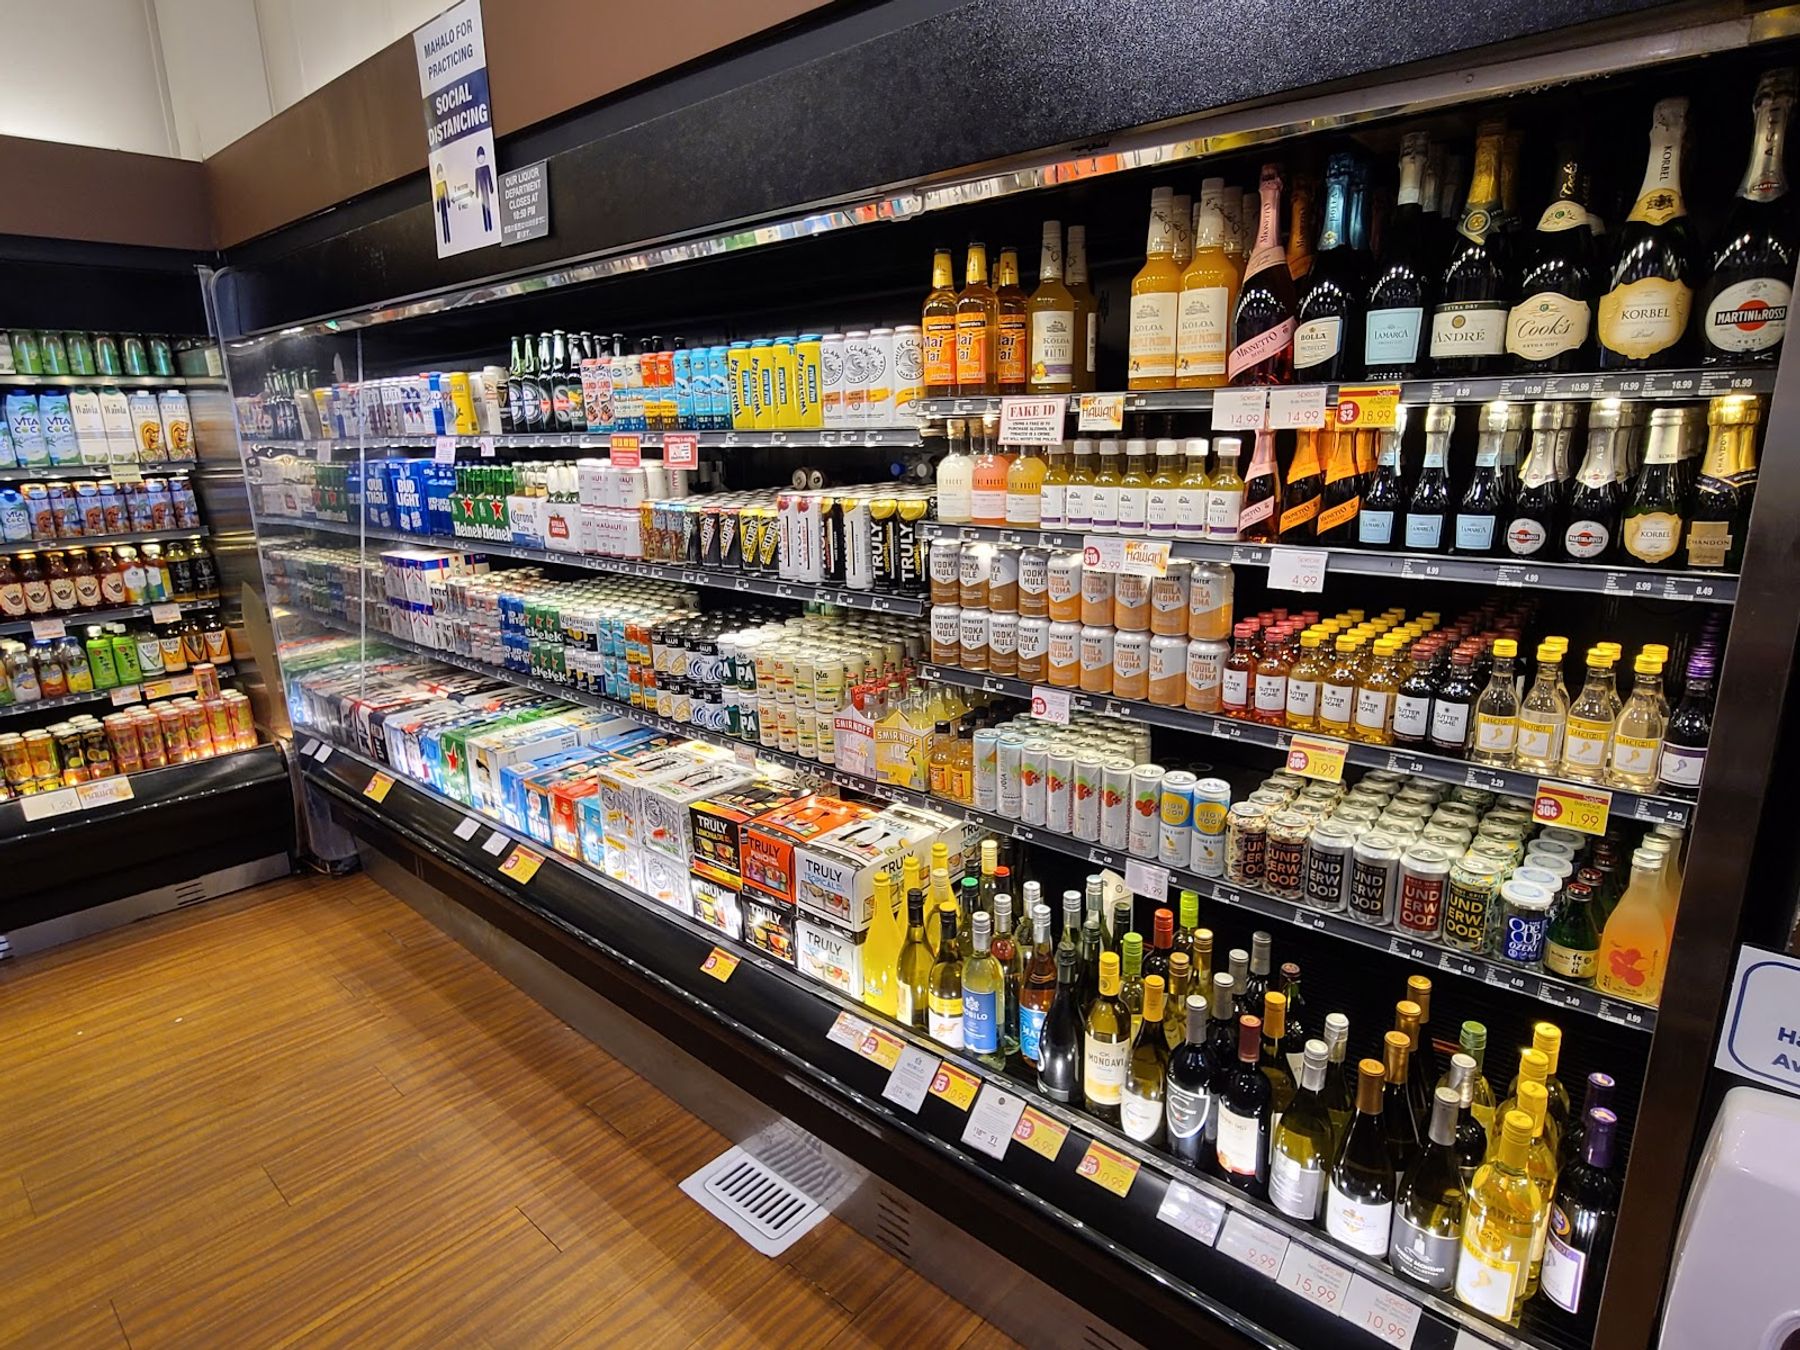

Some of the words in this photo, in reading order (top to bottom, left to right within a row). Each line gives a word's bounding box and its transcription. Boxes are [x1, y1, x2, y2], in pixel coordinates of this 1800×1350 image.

[423, 28, 456, 59] MAHALO
[456, 19, 473, 41] FOR
[427, 43, 474, 81] PRACTICING
[435, 82, 473, 116] SOCIAL
[427, 103, 489, 147] DISTANCING
[1657, 144, 1673, 181] KORBEL
[505, 175, 518, 187] OUR
[518, 167, 540, 183] LIQUOR
[505, 179, 541, 199] DEPARTMENT
[508, 197, 531, 210] CLOSES
[531, 193, 539, 203] AT
[1620, 307, 1672, 321] KORBEL
[1434, 328, 1486, 344] ANDRÉ
[1515, 317, 1575, 340] Cook's
[1300, 332, 1327, 341] BOLLA
[730, 358, 740, 375] TEA
[752, 356, 761, 373] TEA
[797, 353, 807, 369] TEA
[1524, 386, 1542, 395] 10.99
[1571, 382, 1590, 392] 10.99
[1619, 381, 1640, 391] 16.99
[1671, 380, 1693, 390] 16.99
[1730, 378, 1753, 388] 16.99
[730, 376, 742, 418] TWISTED
[751, 372, 762, 417] TWISTED
[798, 369, 808, 416] TWISTED
[1297, 391, 1320, 399] Special
[1377, 388, 1394, 397] Sale
[1010, 406, 1040, 418] FAKE
[1043, 405, 1056, 416] ID
[1230, 414, 1260, 424] 14.99
[1287, 411, 1319, 423] 14.99
[1339, 409, 1355, 422] $2
[1361, 410, 1391, 424] 18.99
[14, 417, 40, 426] VITA
[47, 417, 71, 426] VITA
[396, 479, 415, 494] BUD
[395, 492, 420, 508] LIGHT
[510, 510, 534, 524] Corona
[482, 525, 513, 542] Heinek
[1640, 530, 1672, 539] KORBEL
[870, 522, 884, 579] TRULY
[1688, 539, 1730, 547] CHANDON
[900, 522, 914, 582] TRULY
[1085, 553, 1099, 564] $10
[933, 561, 958, 569] VODKA
[1101, 561, 1121, 570] 5.99
[1022, 569, 1048, 577] VODKA
[1292, 574, 1318, 586] 4.99
[1524, 573, 1539, 583] 4.99
[1024, 577, 1046, 585] MULE
[1696, 586, 1713, 596] 8.49
[935, 622, 959, 630] VODKA
[936, 629, 957, 637] MULE
[992, 630, 1016, 639] VODKA
[994, 637, 1014, 646] MULE
[1189, 652, 1219, 660] CUTWATER
[835, 718, 872, 736] SMIRNOFF
[877, 731, 919, 748] SMIRNOFF
[1312, 761, 1337, 775] 1.99
[697, 815, 727, 834] TRULY
[1569, 810, 1599, 827] 1.99
[695, 827, 724, 843] LEMONADE
[961, 824, 980, 836] TRU
[749, 837, 781, 858] TRULY
[805, 858, 843, 880] TRULY
[1310, 858, 1341, 872] UND
[803, 872, 837, 890] TROPICAL
[1309, 870, 1340, 883] ERW
[1353, 870, 1383, 886] UND
[1308, 883, 1339, 897] OOD
[1352, 884, 1382, 898] ERW
[1405, 886, 1439, 901] UND
[1351, 896, 1381, 910] OOD
[1404, 899, 1438, 914] ERW
[1450, 895, 1483, 914] UND
[749, 903, 782, 924] TRULY
[1402, 910, 1437, 925] OOD
[1448, 906, 1482, 924] ERW
[1446, 918, 1481, 937] OOD
[806, 930, 843, 950] TRULY
[1508, 942, 1538, 952] OZEKI
[1088, 1053, 1126, 1069] MONDAVI
[1247, 1247, 1277, 1270] 9.99
[1295, 1273, 1337, 1303] 15.99
[1366, 1310, 1406, 1340] 10.99
